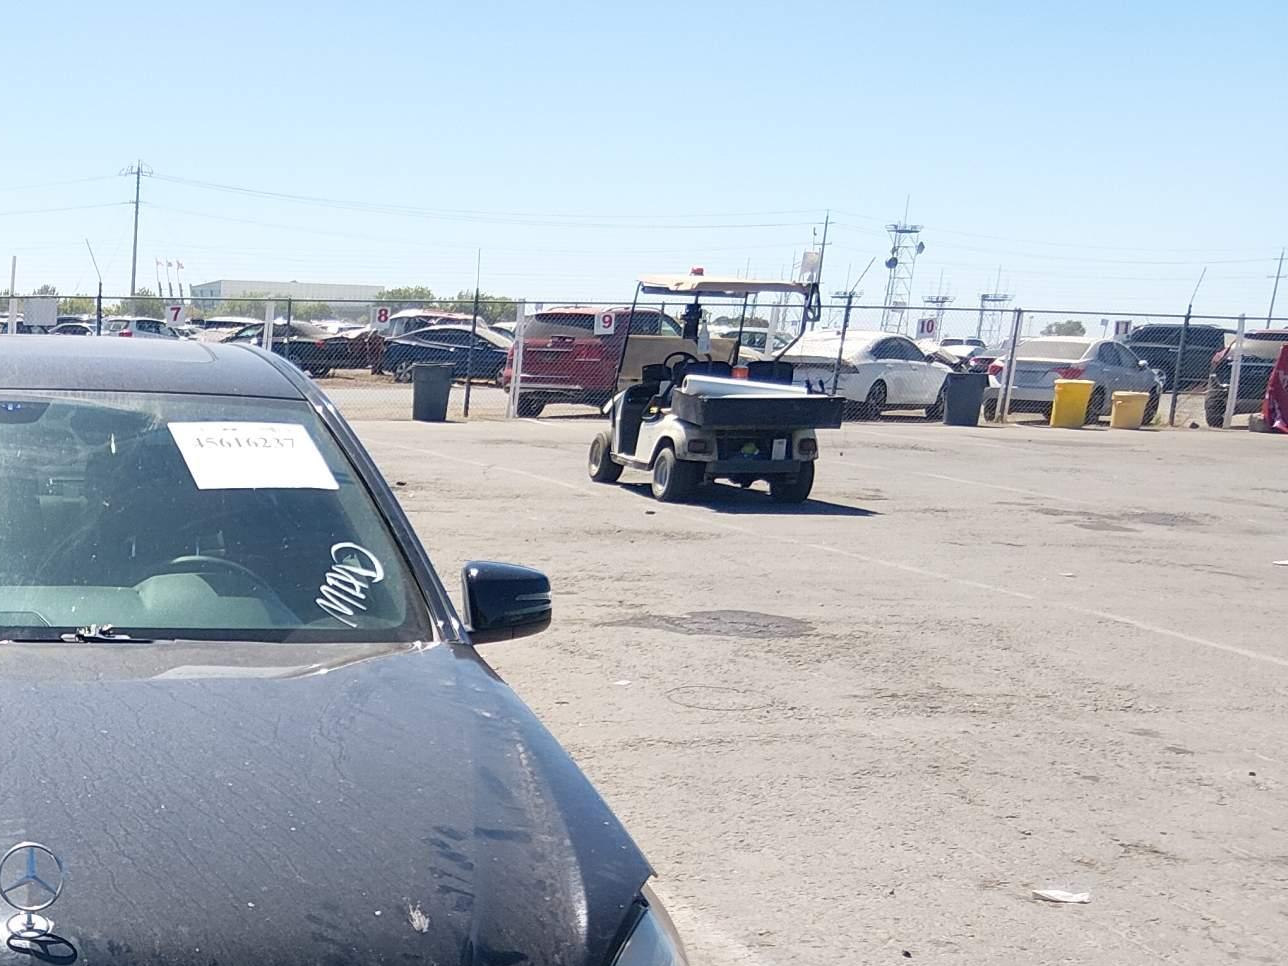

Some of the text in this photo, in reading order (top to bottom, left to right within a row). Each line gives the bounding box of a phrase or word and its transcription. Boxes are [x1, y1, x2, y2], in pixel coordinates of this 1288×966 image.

[170, 307, 181, 321] 7
[377, 308, 389, 323] 8
[602, 314, 613, 329] 9
[920, 319, 934, 333] 10
